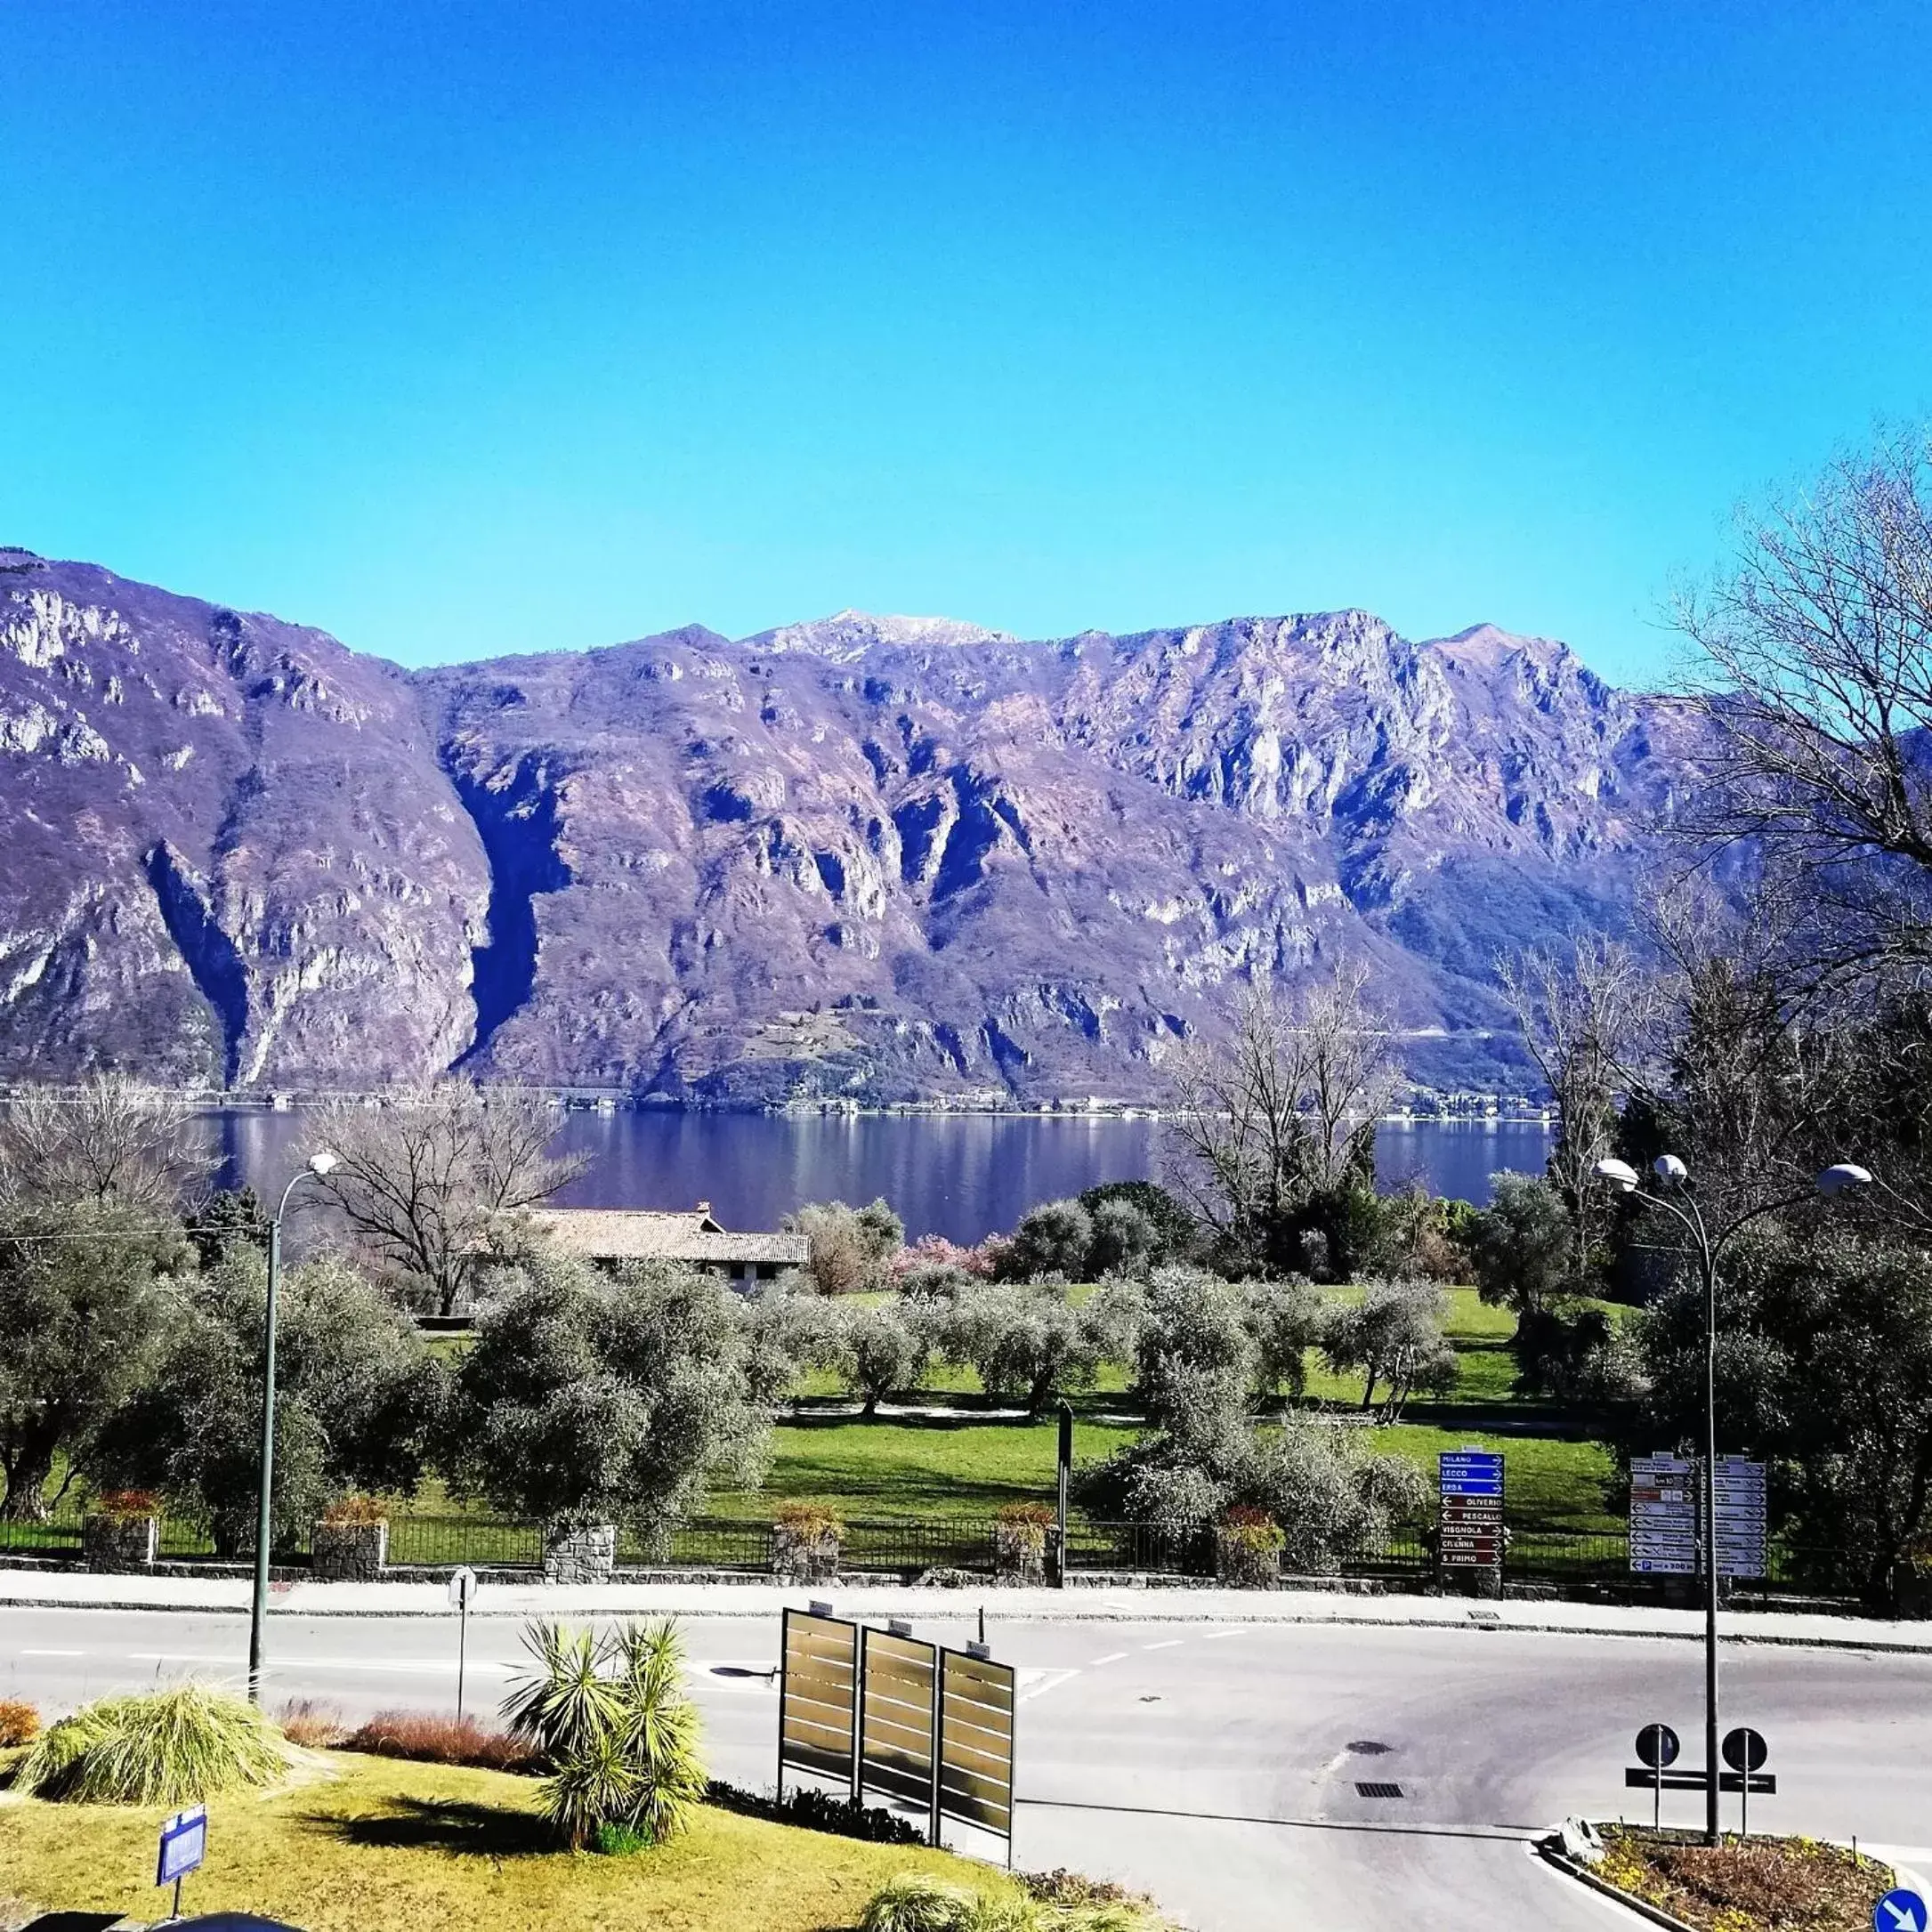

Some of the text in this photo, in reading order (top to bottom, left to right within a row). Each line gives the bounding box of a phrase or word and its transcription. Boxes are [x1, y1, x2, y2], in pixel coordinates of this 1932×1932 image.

[1442, 1469, 1467, 1477] LECCO
[1467, 1498, 1502, 1507] OLIVERIO
[1462, 1513, 1502, 1521] PESCALLO
[1451, 1555, 1477, 1563] PRIMO
